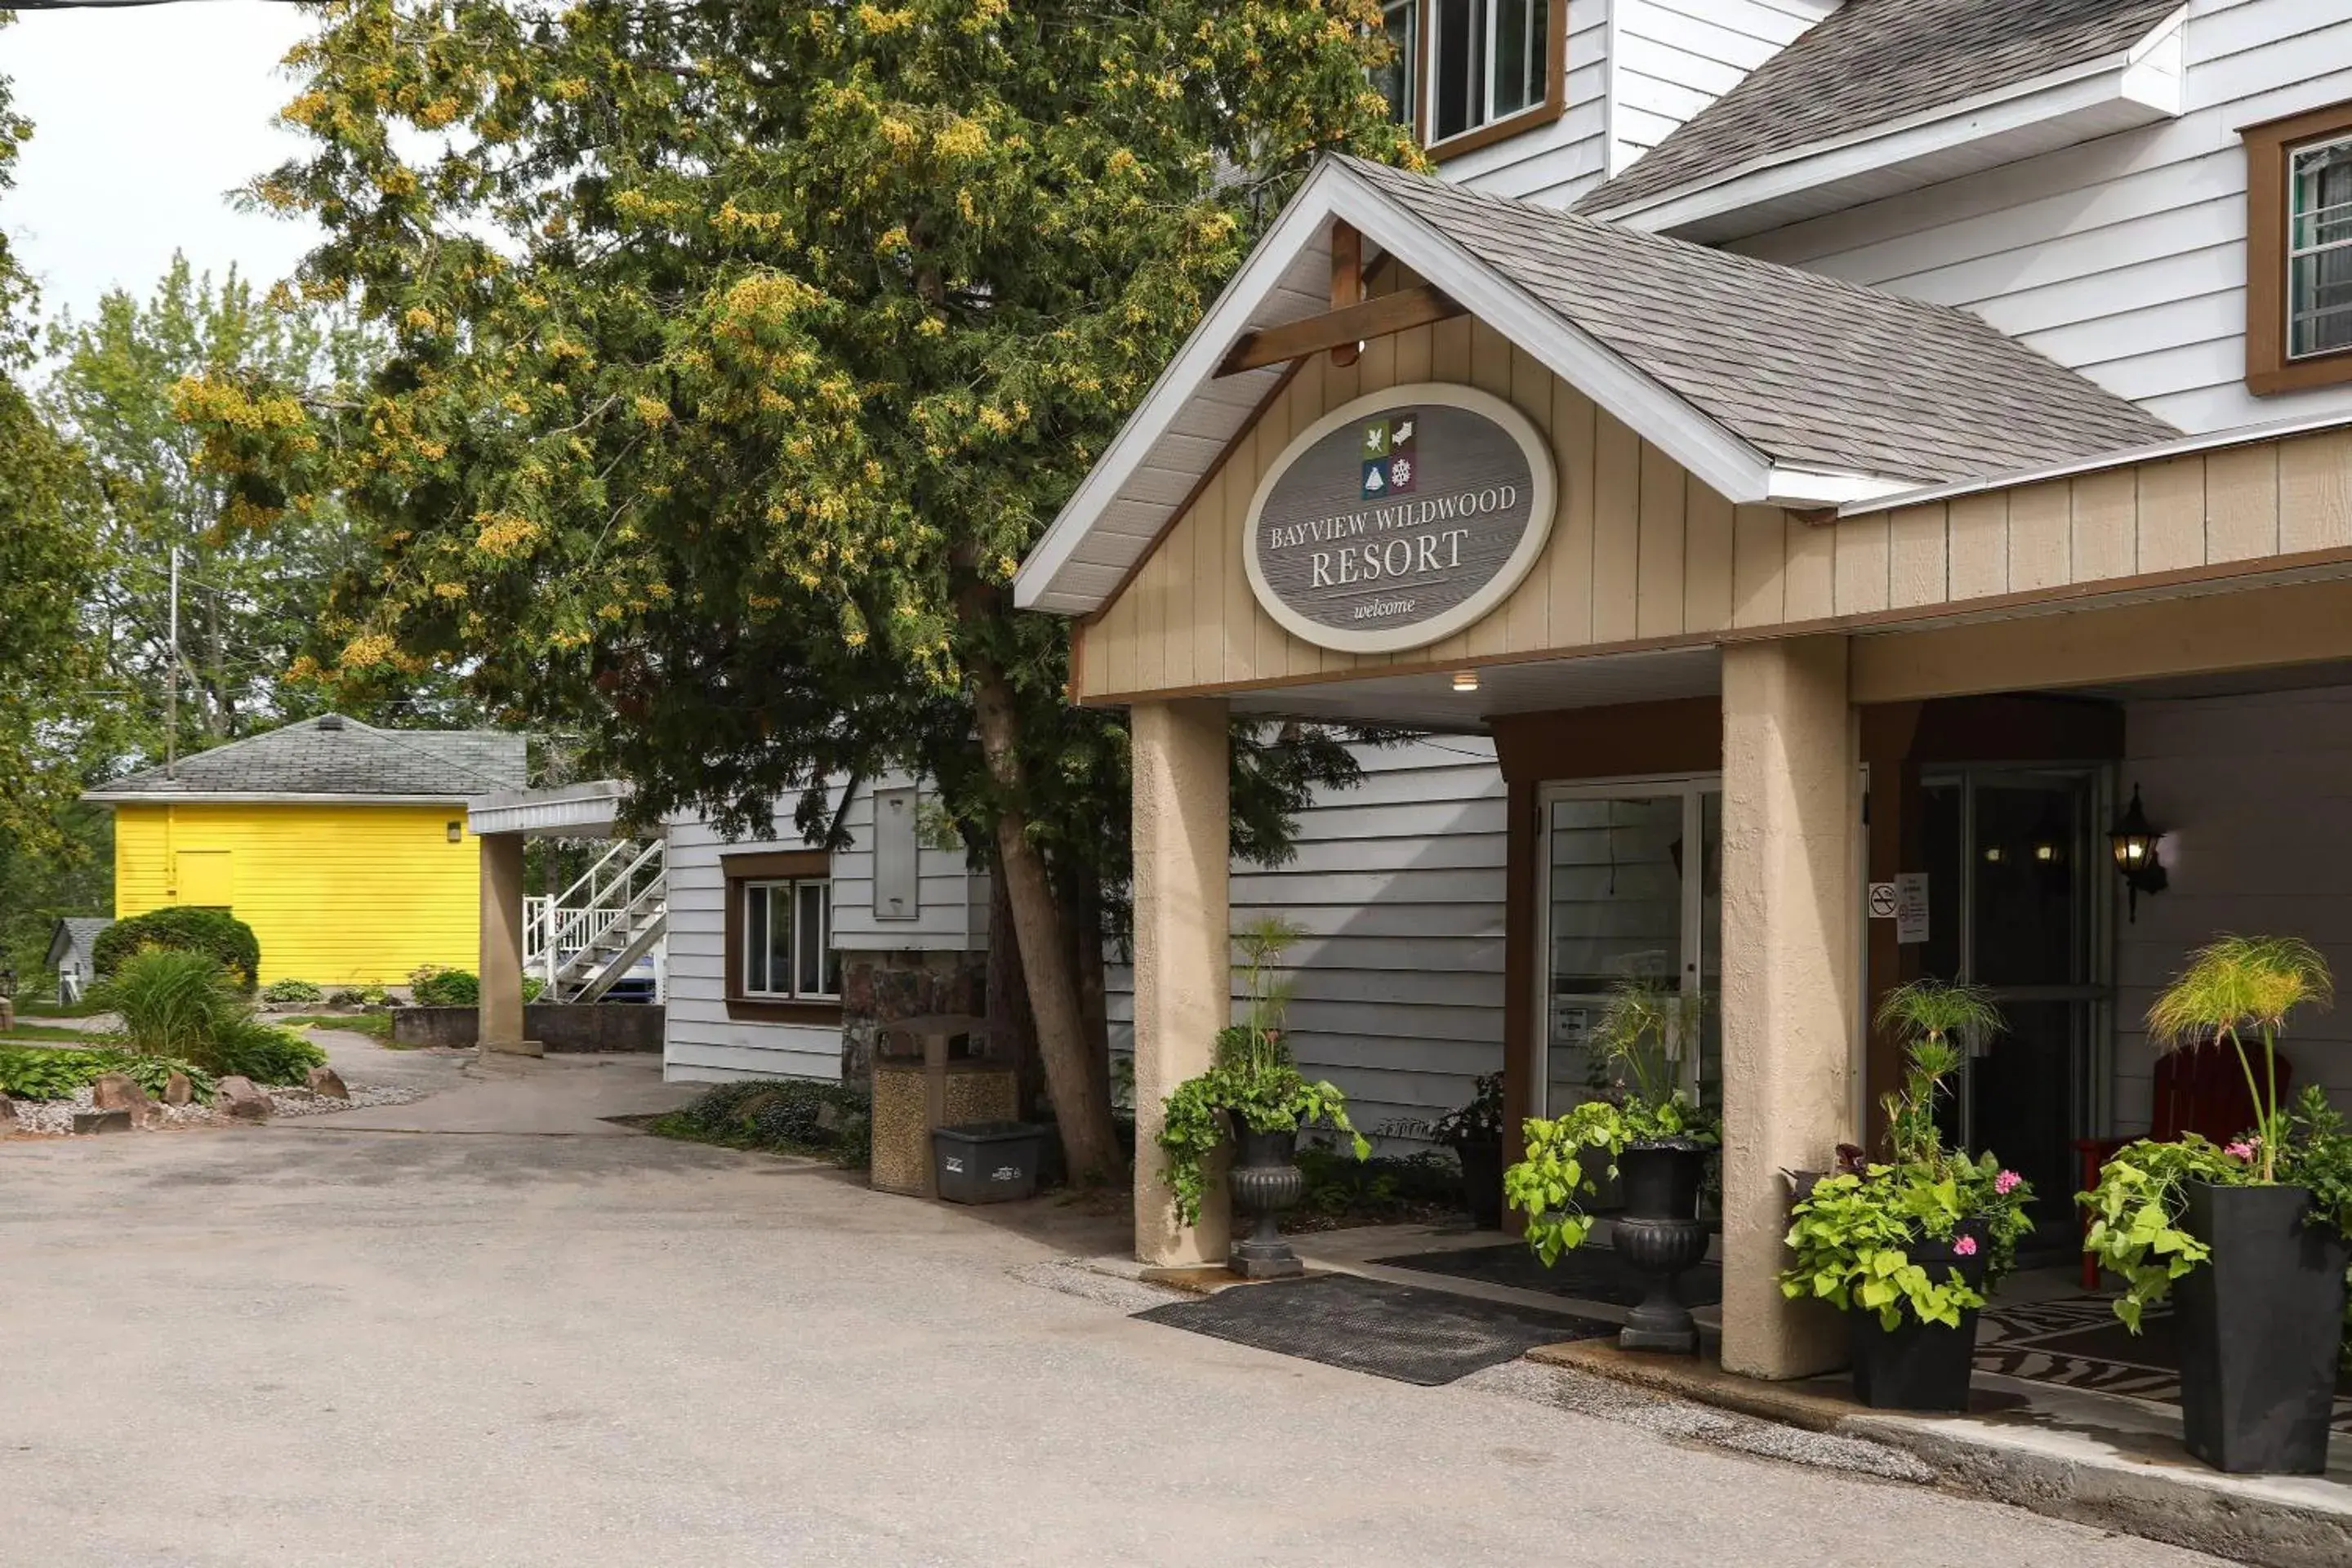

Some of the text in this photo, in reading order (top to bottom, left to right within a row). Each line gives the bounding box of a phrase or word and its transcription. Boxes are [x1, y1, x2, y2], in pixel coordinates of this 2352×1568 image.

[1270, 485, 1516, 549] BAYVIEW WILDWOOD
[1311, 529, 1468, 588] RESORT
[1353, 598, 1415, 619] welcome
